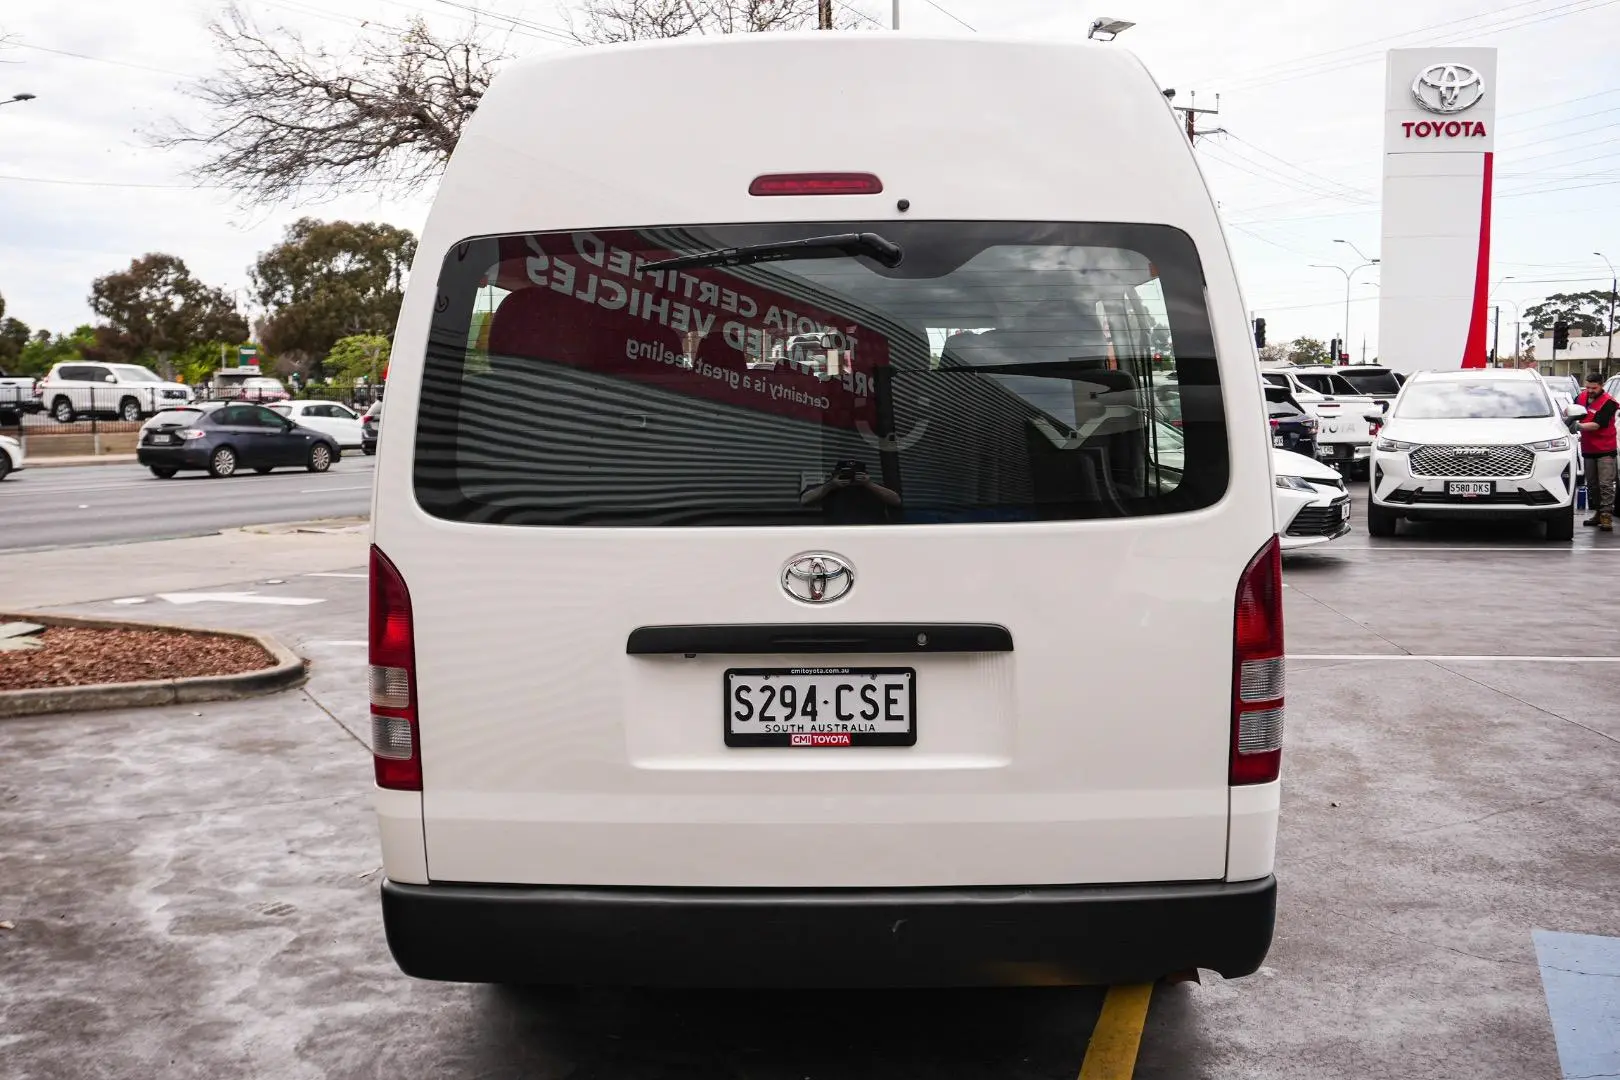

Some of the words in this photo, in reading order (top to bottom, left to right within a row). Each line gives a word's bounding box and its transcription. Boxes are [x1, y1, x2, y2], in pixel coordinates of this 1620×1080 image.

[1401, 121, 1487, 138] TOYOTA
[790, 667, 850, 675] cmitoyota.com.au
[765, 724, 805, 733] SOUTH
[810, 723, 876, 733] AUSTRALIA
[793, 735, 811, 744] CMI
[812, 735, 850, 744] TOYOTA
